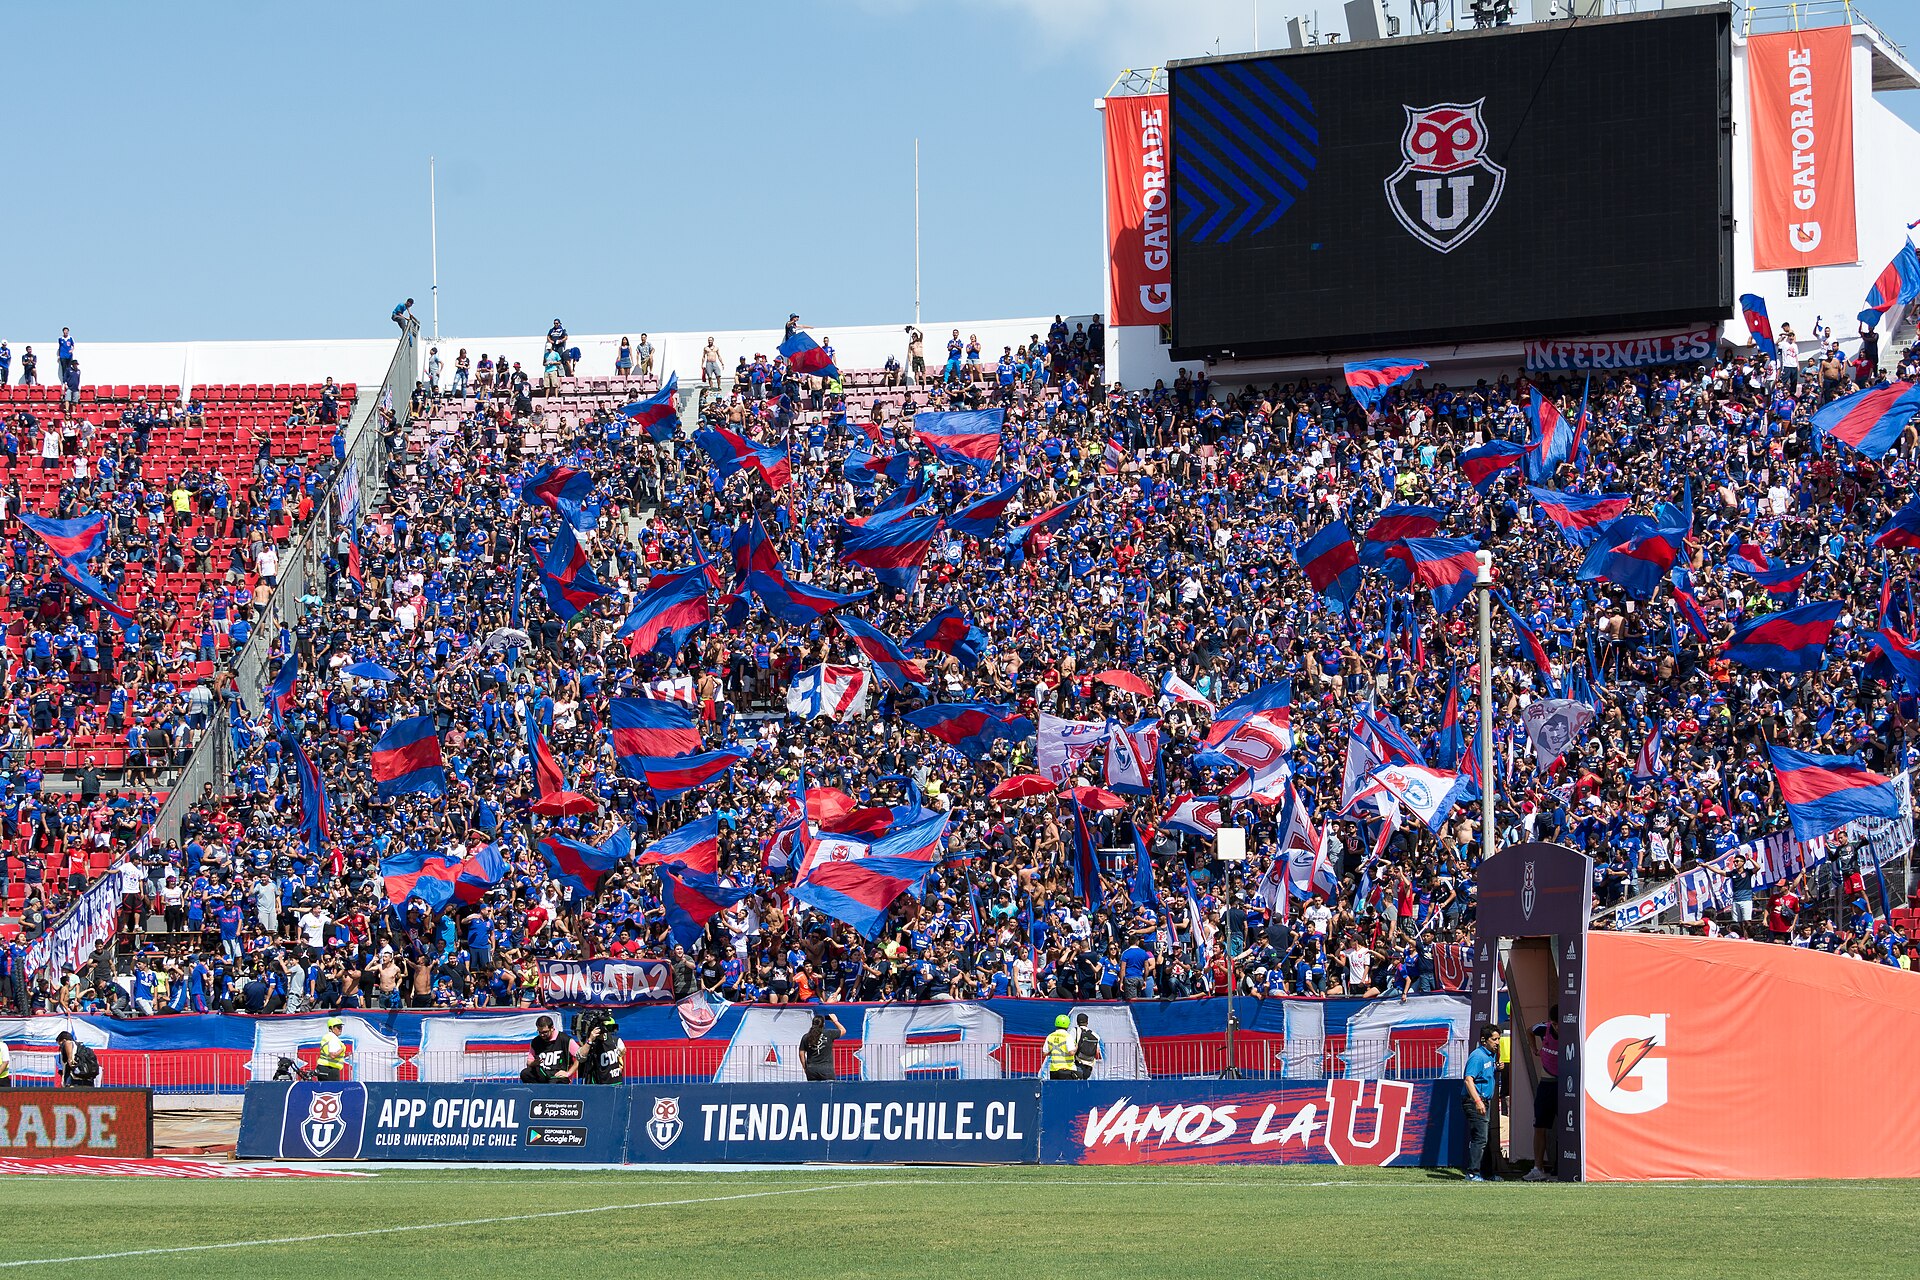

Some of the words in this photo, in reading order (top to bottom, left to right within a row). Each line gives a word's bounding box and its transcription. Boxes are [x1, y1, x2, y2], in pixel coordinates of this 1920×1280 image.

[1788, 48, 1816, 210] GATORADE
[1141, 108, 1168, 271] GATORADE
[1525, 331, 1710, 370] INFERNALES
[378, 1099, 427, 1128] APP
[432, 1099, 519, 1128] OFICIAL
[544, 1108, 559, 1117] App
[560, 1108, 579, 1116] Store
[700, 1101, 1023, 1141] TIENDA.UDECHILE.CL
[1084, 1096, 1241, 1150] VAMOS
[1250, 1102, 1326, 1150] LA
[1324, 1079, 1414, 1167] U
[375, 1133, 401, 1146] CLUB
[404, 1133, 470, 1146] UNIVERSIDAD
[472, 1134, 486, 1146] DE
[488, 1134, 518, 1147] CHILE
[543, 1134, 568, 1145] Google
[568, 1134, 583, 1145] Play
